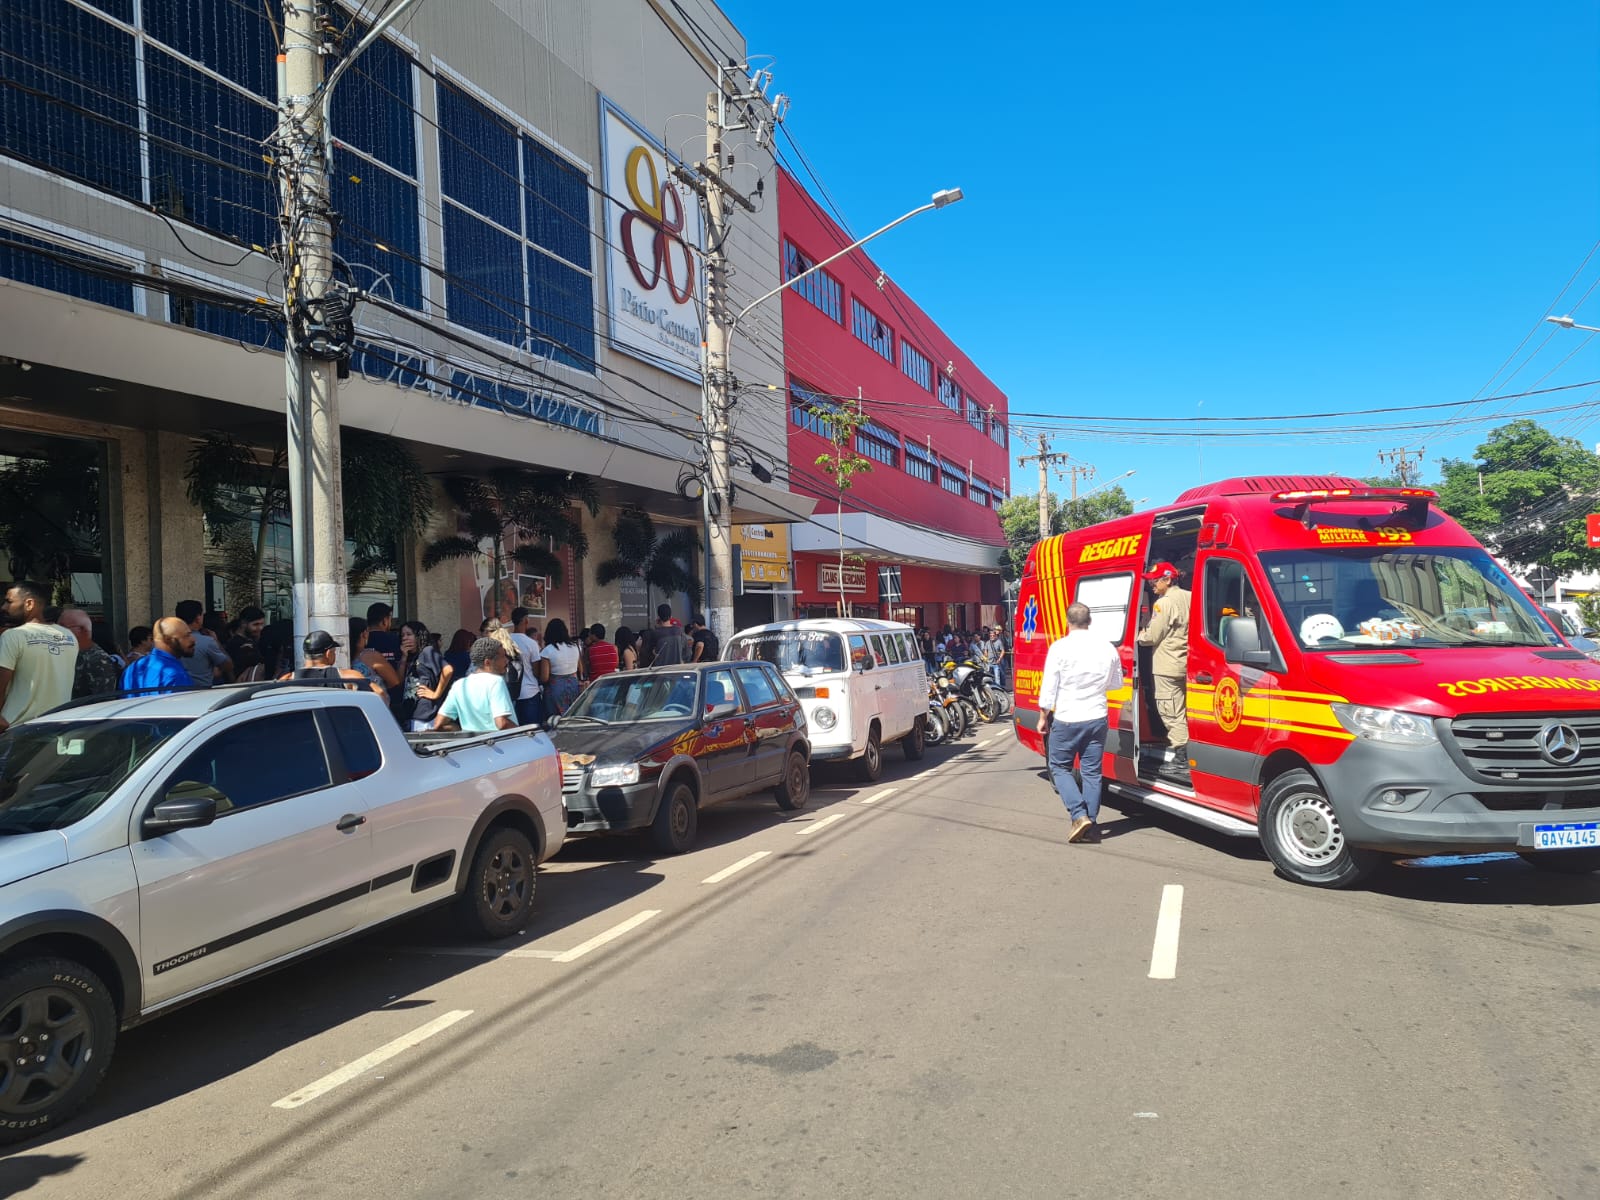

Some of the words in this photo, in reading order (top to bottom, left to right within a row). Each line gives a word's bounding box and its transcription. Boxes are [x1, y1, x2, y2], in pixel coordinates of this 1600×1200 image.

[656, 309, 699, 347] Central
[1375, 527, 1411, 541] 193
[1079, 534, 1142, 563] RESGATE
[823, 571, 838, 584] LOJAS
[840, 572, 865, 585] MERICANAS
[155, 947, 206, 971] TROOPER
